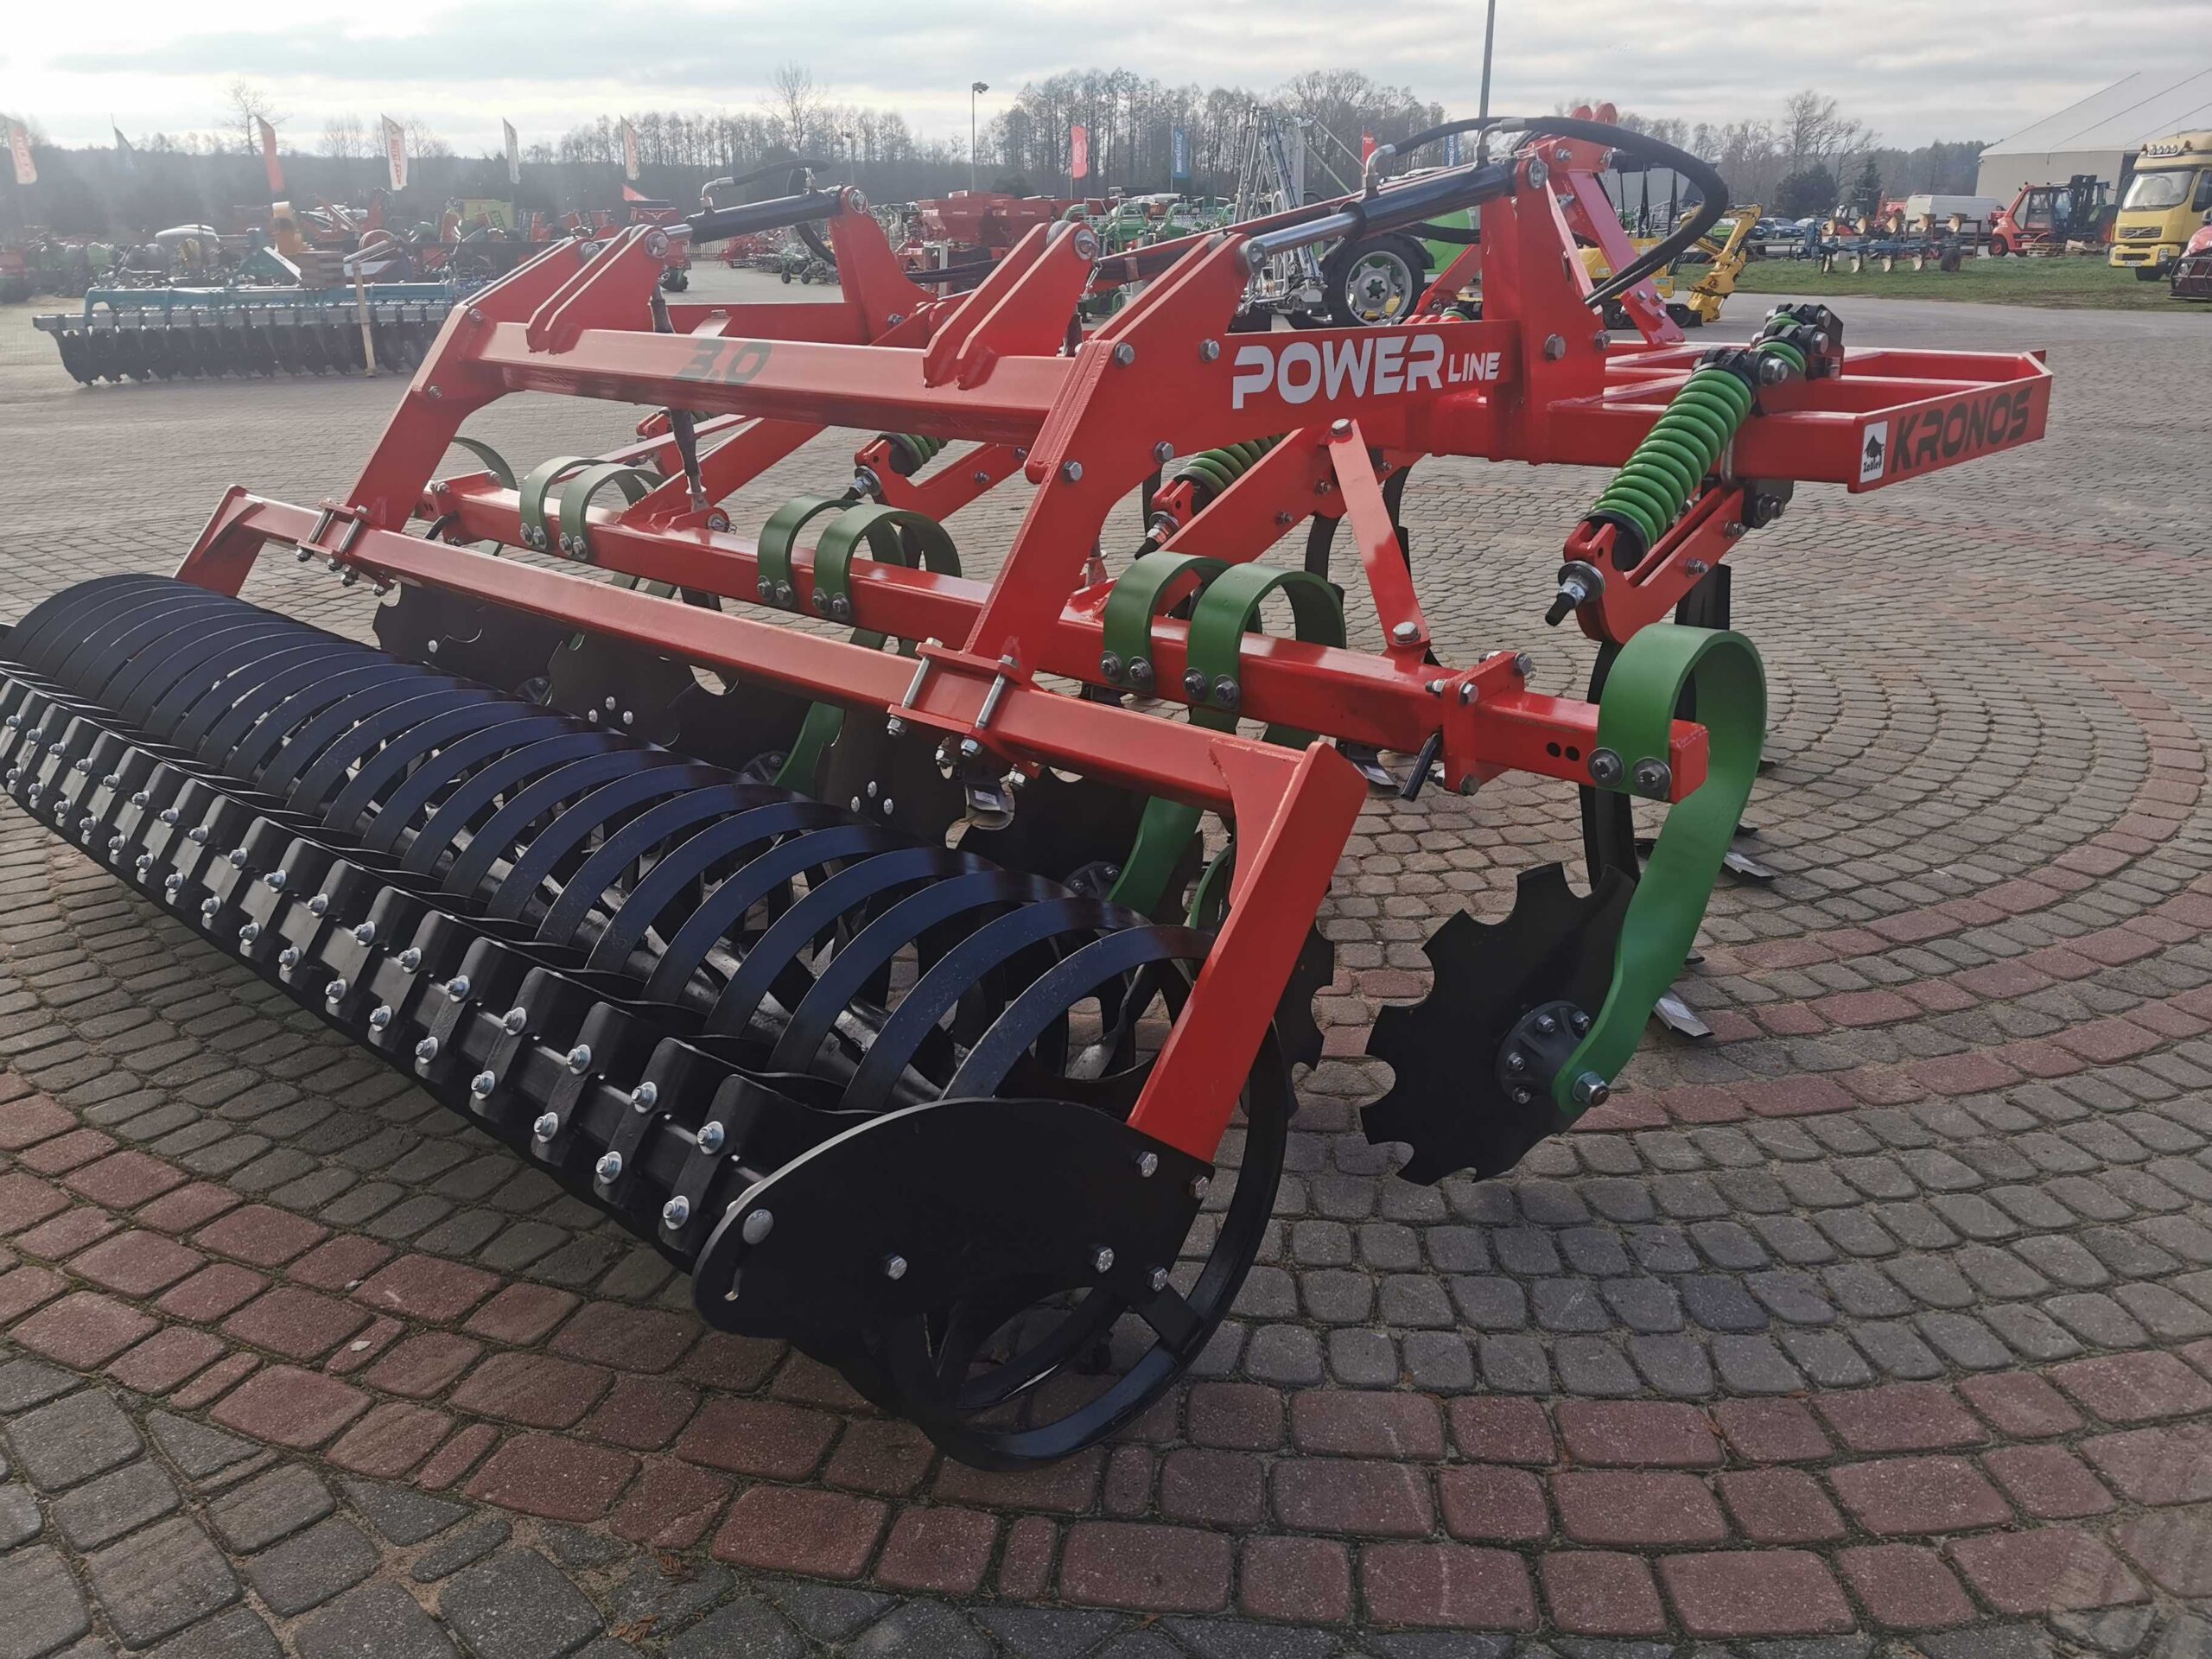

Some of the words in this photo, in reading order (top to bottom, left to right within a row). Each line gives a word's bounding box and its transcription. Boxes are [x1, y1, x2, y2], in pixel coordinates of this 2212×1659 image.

[673, 339, 772, 385] 3.0
[1232, 334, 1445, 410] POWER
[1448, 352, 1501, 383] LINE
[1891, 386, 2033, 474] KRONOS
